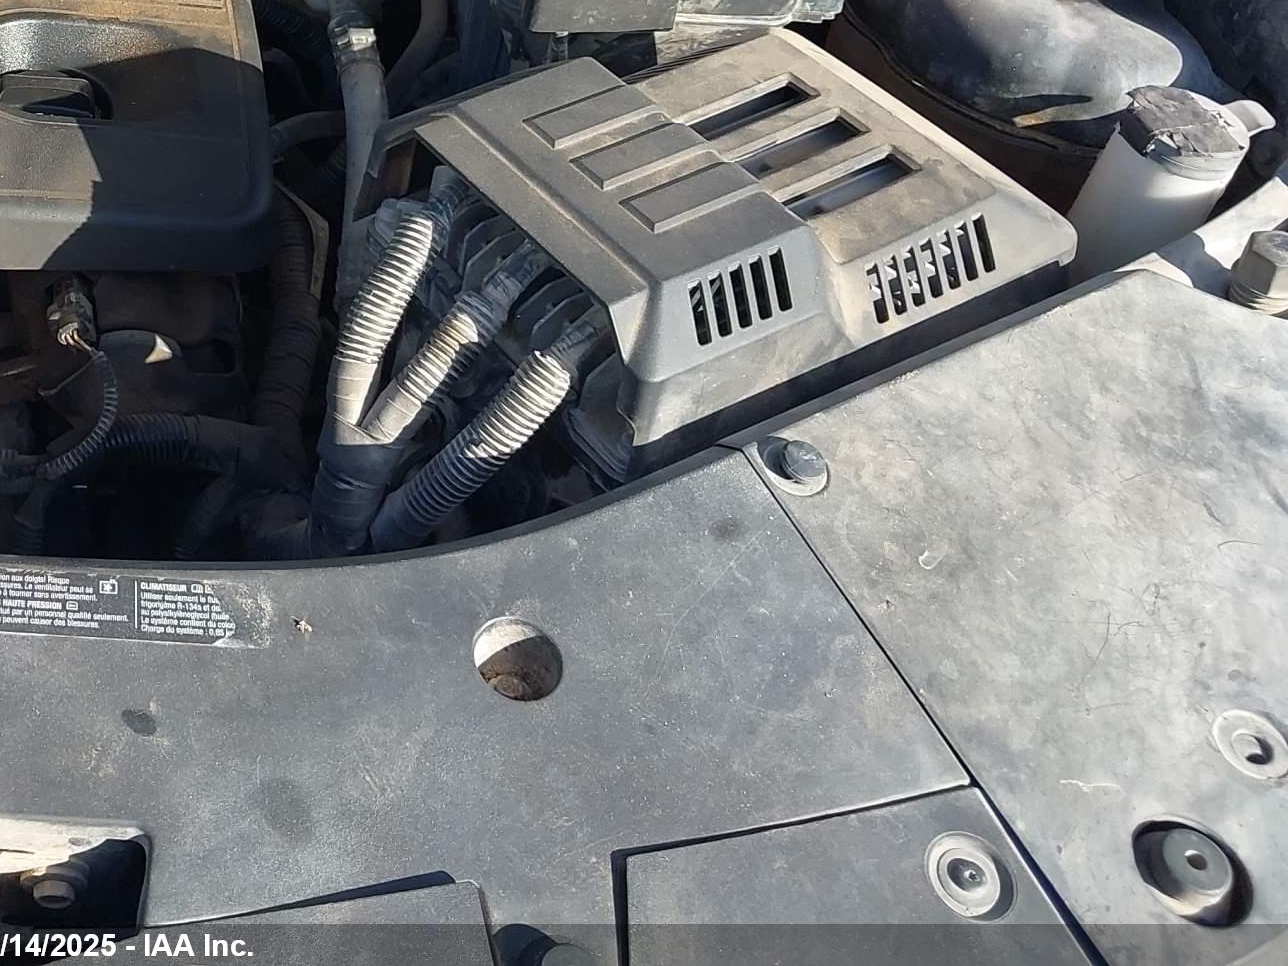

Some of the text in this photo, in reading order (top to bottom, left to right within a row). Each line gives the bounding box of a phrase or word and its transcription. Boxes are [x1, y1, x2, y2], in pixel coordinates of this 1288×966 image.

[140, 581, 187, 593] CLIMATISEUR
[2, 598, 26, 608] HAUTE
[27, 600, 63, 610] PRESSION
